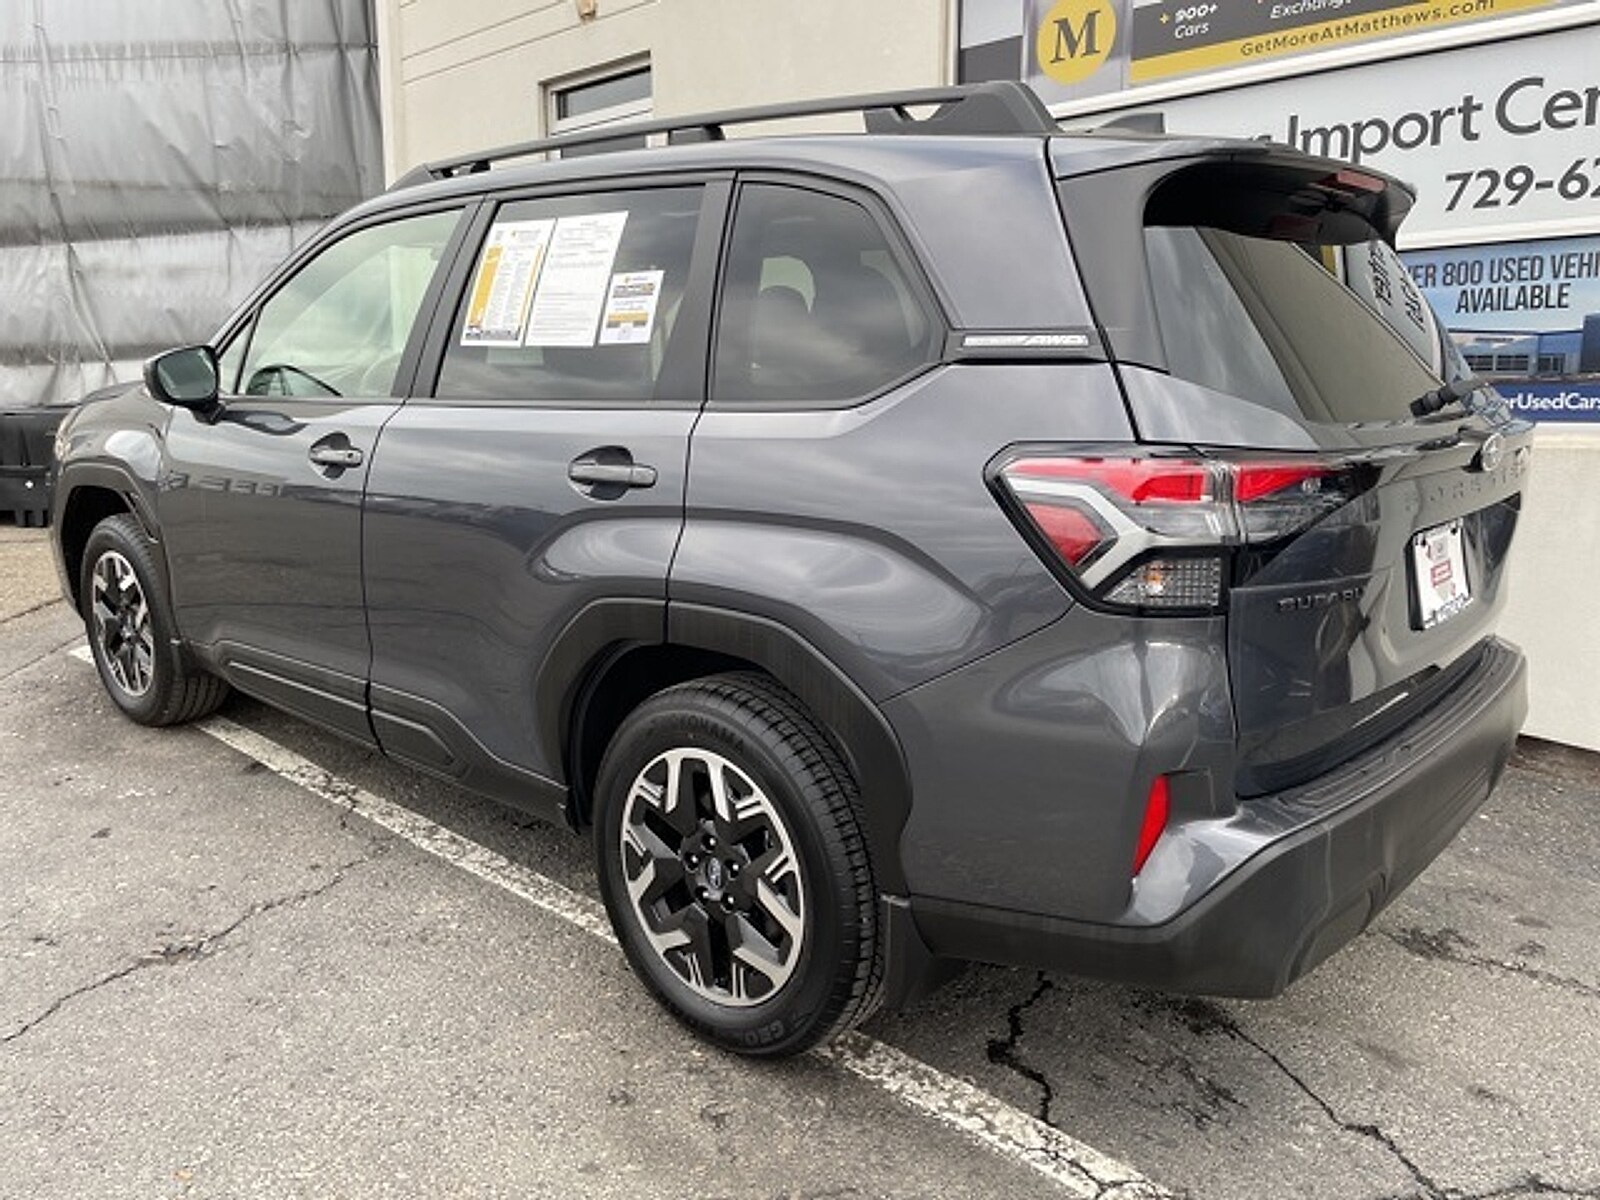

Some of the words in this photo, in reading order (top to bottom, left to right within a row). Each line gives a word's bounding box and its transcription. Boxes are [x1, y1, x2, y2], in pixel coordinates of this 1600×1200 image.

[1049, 10, 1102, 64] M
[1174, 22, 1210, 39] Cars
[1287, 95, 1483, 164] Import
[1442, 260, 1483, 286] 800
[1490, 255, 1544, 284] USED
[1455, 283, 1572, 314] AVAILABLE
